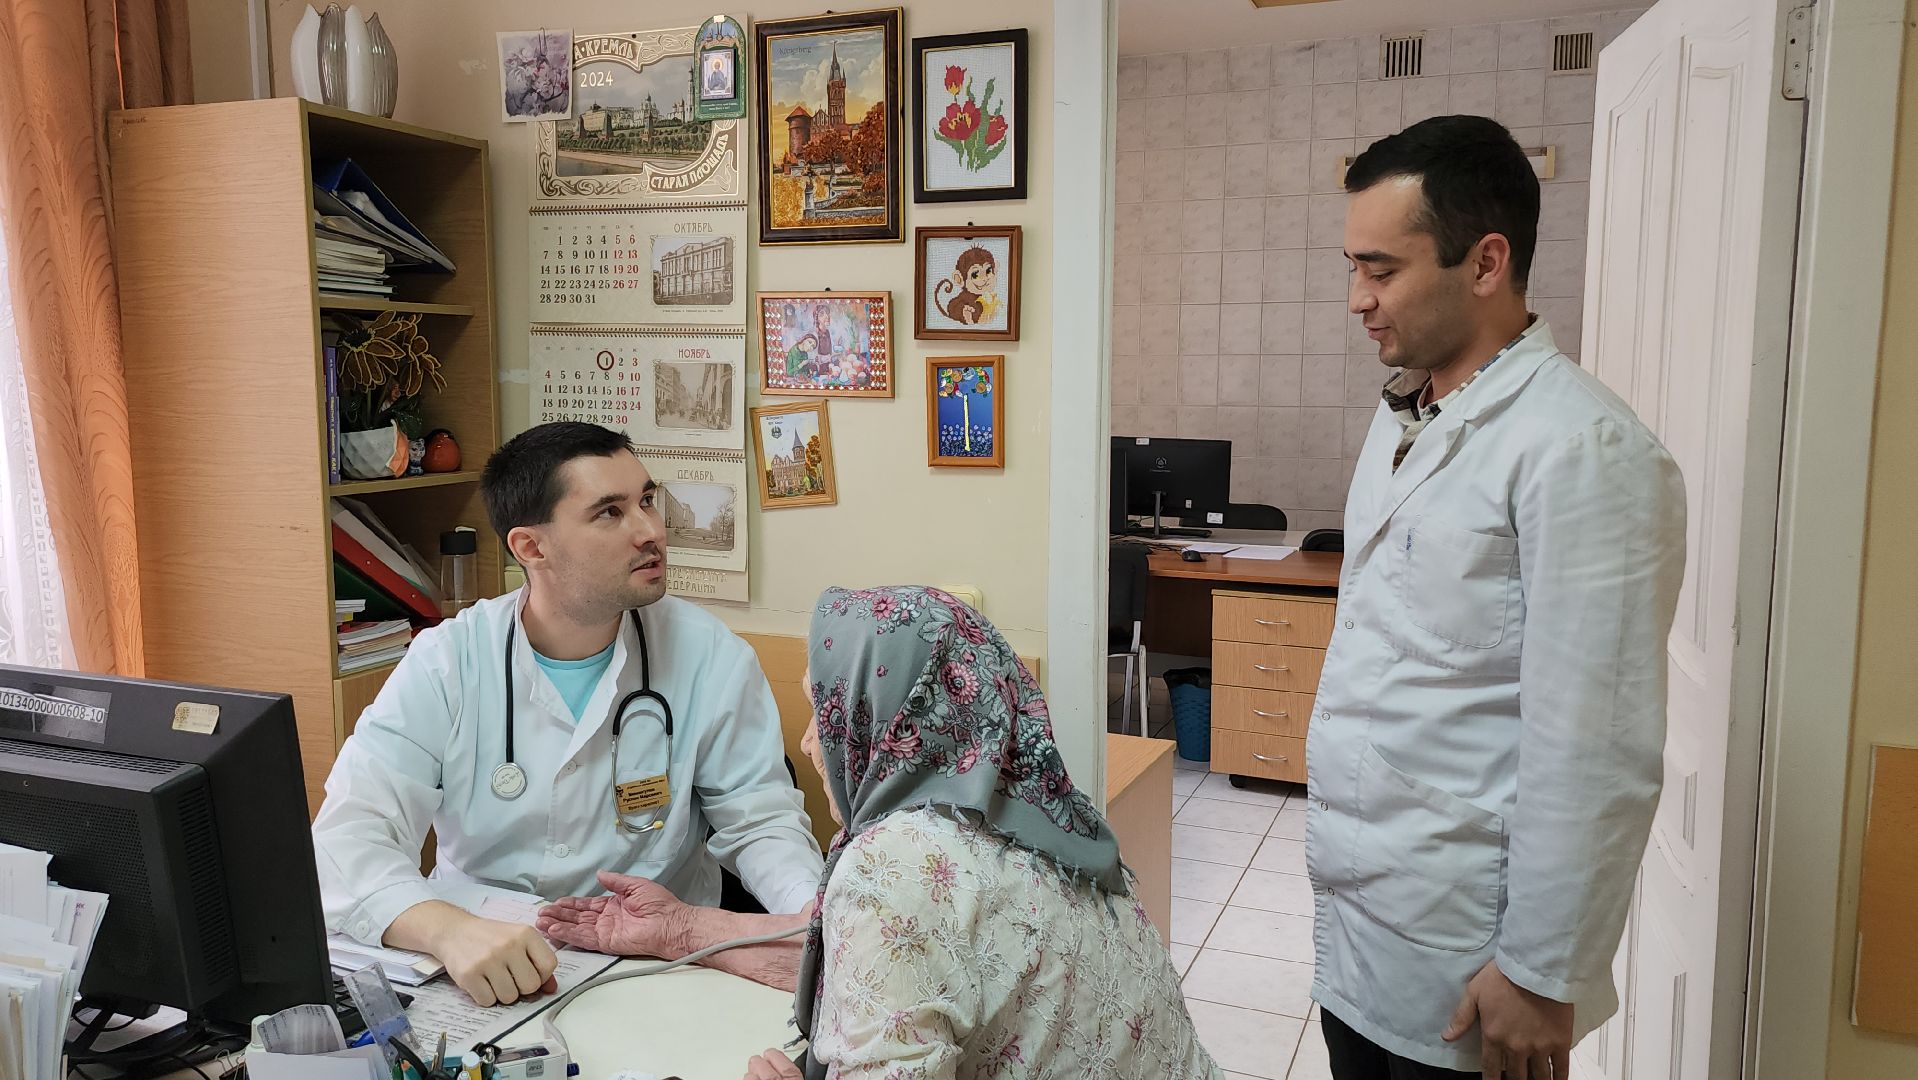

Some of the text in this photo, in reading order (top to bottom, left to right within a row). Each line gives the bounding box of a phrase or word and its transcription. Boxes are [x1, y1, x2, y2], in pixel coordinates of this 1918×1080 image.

[580, 71, 614, 88] 2024
[650, 174, 690, 189] СТАРАЯ
[673, 222, 713, 233] ОКТЯБРЬ
[558, 234, 636, 246] 1 2 3 4 5 6
[544, 248, 638, 260] 7 8 9 10 11 12 13
[540, 264, 638, 274] 14 15 16 17 18 19 20
[540, 280, 638, 290] 21 22 23 24 25 26 27
[540, 294, 596, 304] 28 29 30 31
[678, 348, 711, 359] НОЯБРЬ
[604, 356, 638, 368] 1 2 3
[544, 370, 640, 382] 4 5 6 7 8 9 10
[544, 384, 640, 396] 11 12 13 14 15 16 17
[542, 398, 642, 410] 18 19 20 21 22 23 24
[542, 412, 628, 424] 25 26 27 28 29 30
[677, 469, 715, 481] ДЕКАБРЬ
[666, 579, 716, 593] ЕДЕРАЦИИ
